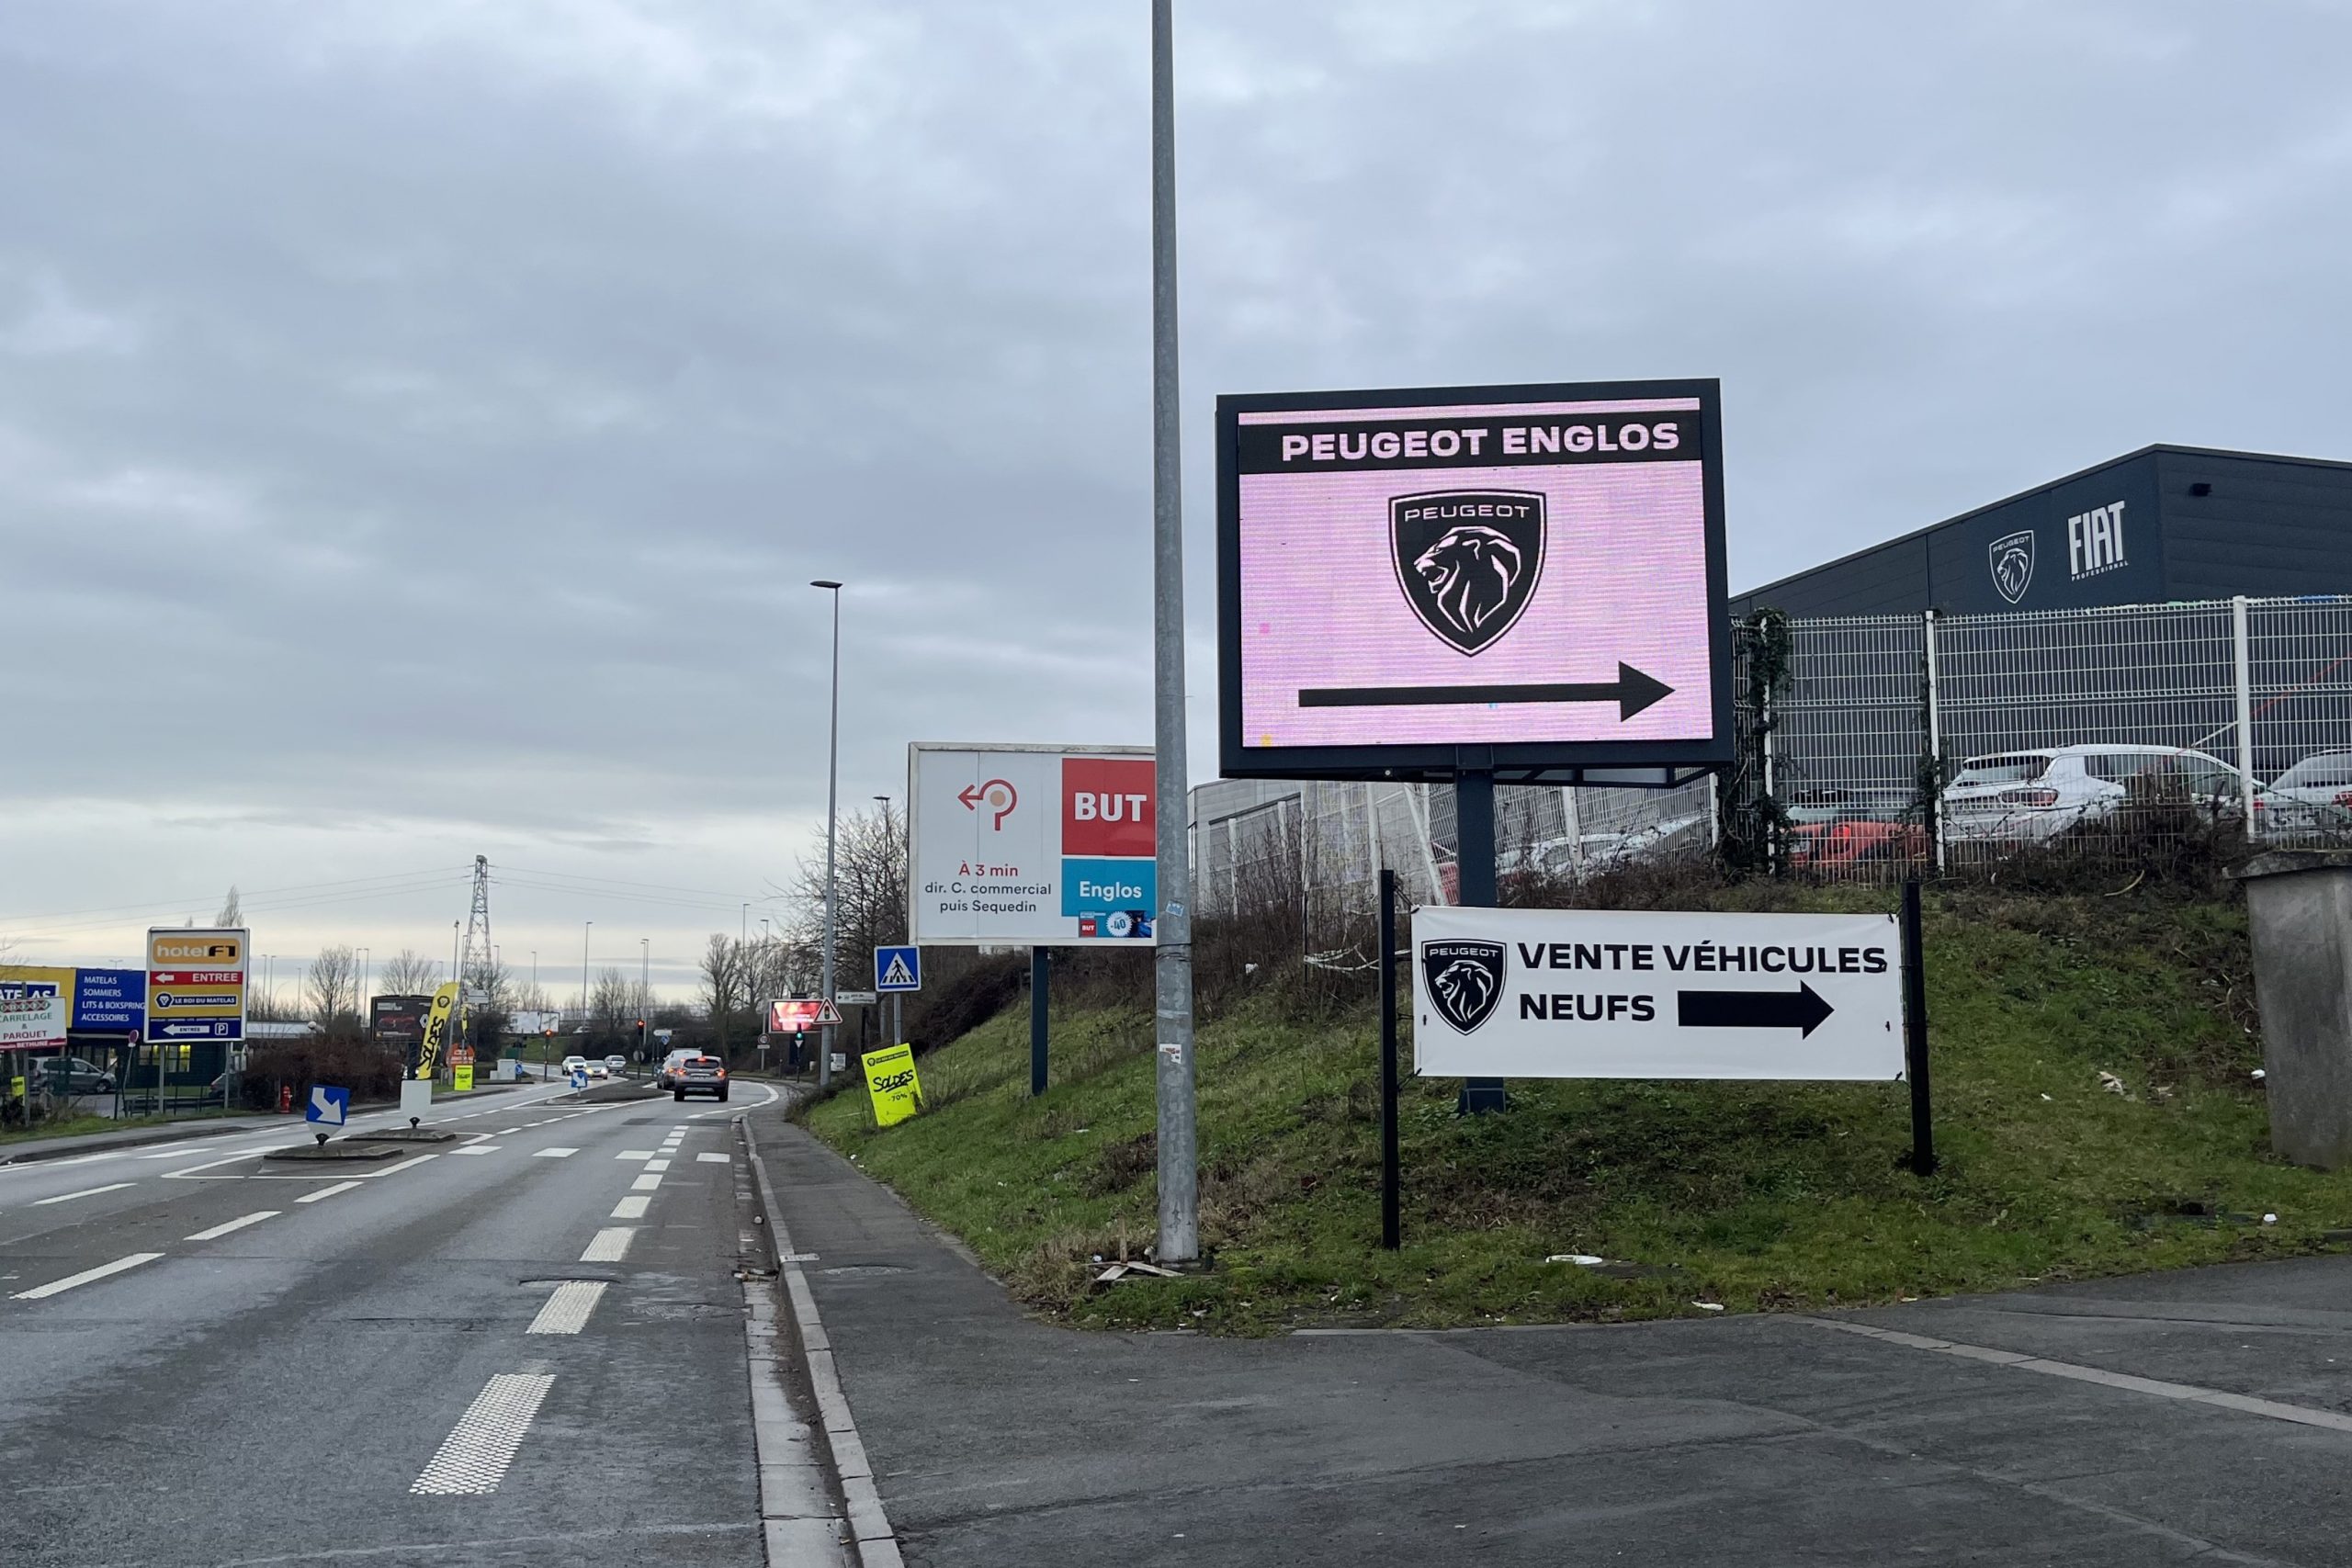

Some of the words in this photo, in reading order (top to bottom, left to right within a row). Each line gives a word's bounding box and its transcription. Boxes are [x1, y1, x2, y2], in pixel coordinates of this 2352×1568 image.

[1283, 429, 1488, 461] PEUGEOT
[1503, 423, 1679, 455] ENGLOS
[1405, 505, 1531, 523] PEUGEOT
[1993, 536, 2030, 553] PEUGEOT
[2068, 501, 2125, 575] FIAT
[2071, 560, 2129, 581] PROFESSIONAL
[1075, 793, 1148, 821] BUT
[958, 860, 971, 876] À
[975, 864, 985, 876] 3
[989, 863, 1019, 876] min
[924, 882, 947, 894] dir.
[951, 883, 967, 894] C.
[970, 883, 1051, 895] commercial
[1080, 881, 1142, 902] Englos
[940, 900, 968, 914] puis
[972, 900, 1036, 915] Sequedin
[1430, 947, 1498, 957] PEUGEOT
[1518, 942, 1655, 971] VENTE
[1663, 940, 1888, 974] VÉHICULES
[84, 976, 118, 985] MATELAS
[83, 988, 122, 998] SOMMIERS
[82, 1000, 97, 1009] LITS
[1521, 994, 1656, 1021] NEUFS
[81, 1013, 130, 1021] ACCESSOIRES
[3, 1030, 48, 1040] PARQUET
[873, 1069, 914, 1093] SOLDES
